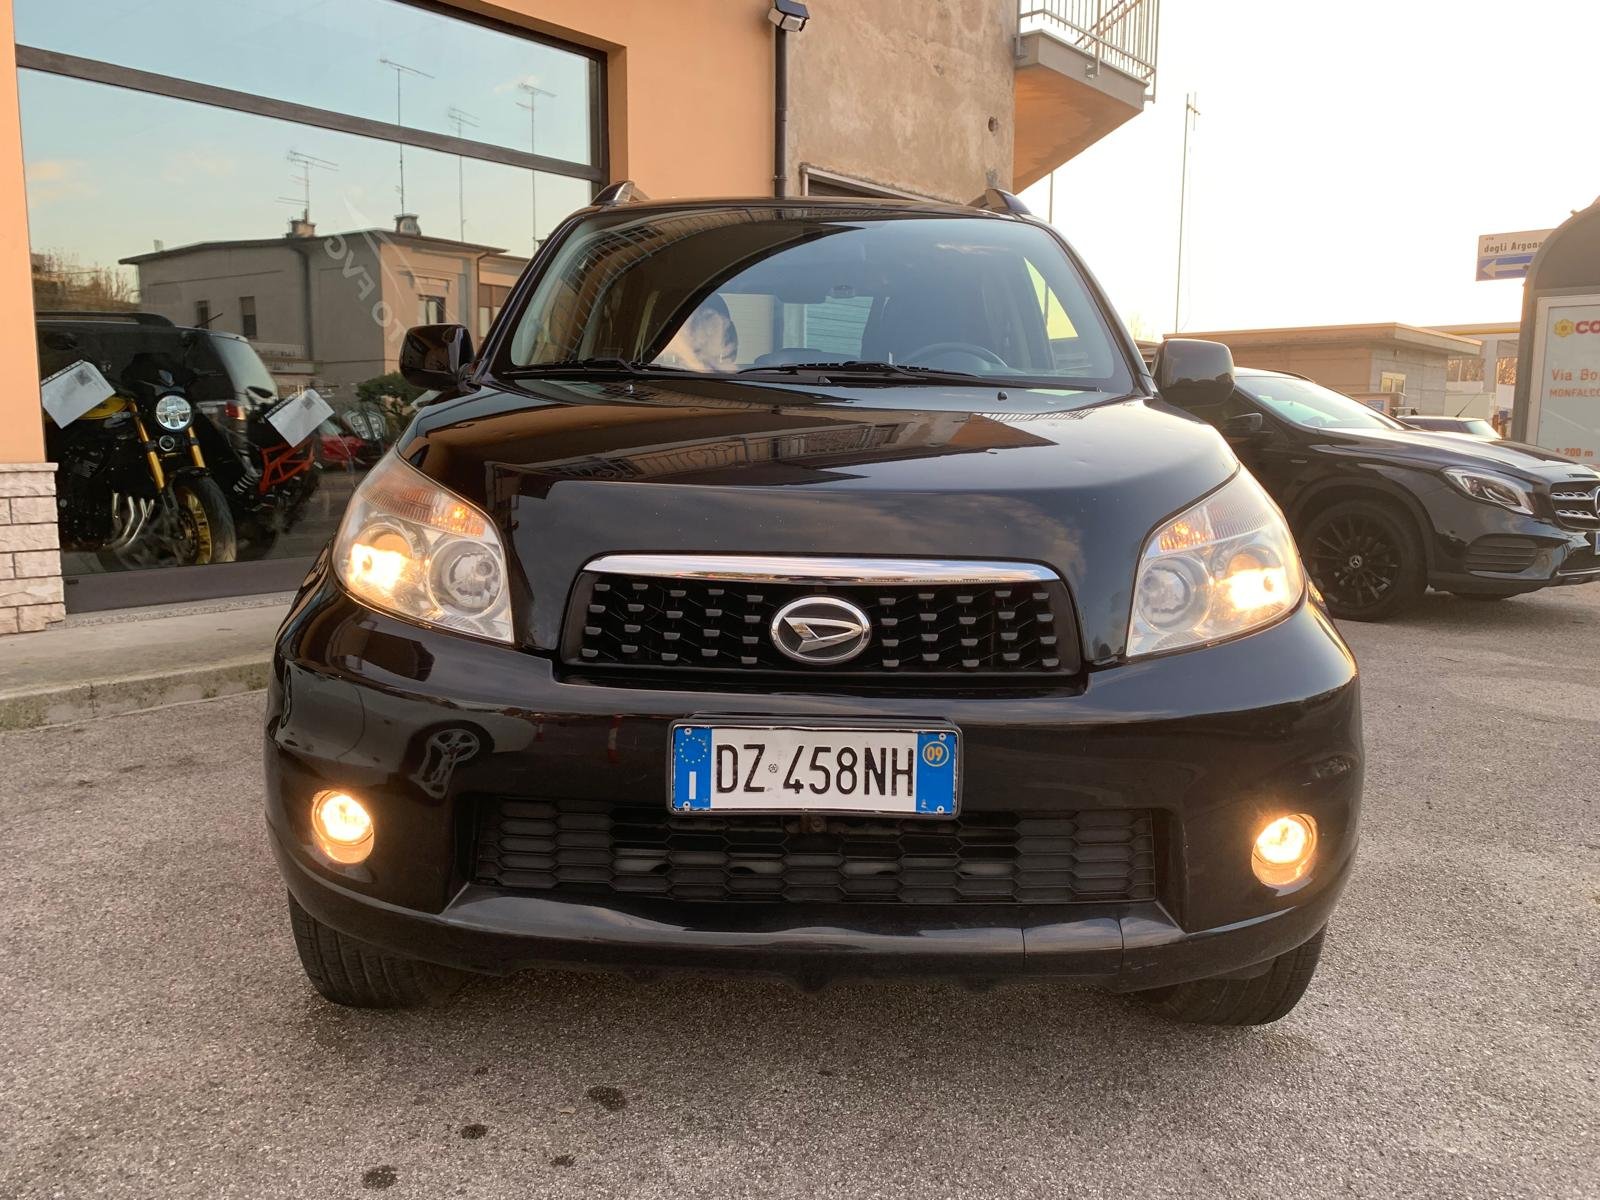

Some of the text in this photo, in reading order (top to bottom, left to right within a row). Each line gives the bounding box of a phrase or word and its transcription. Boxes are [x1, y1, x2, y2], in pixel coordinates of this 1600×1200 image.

[1484, 242, 1507, 254] degli
[1551, 368, 1600, 381] Via Bo
[927, 746, 943, 761] 09
[716, 743, 914, 797] DZ 458NH
